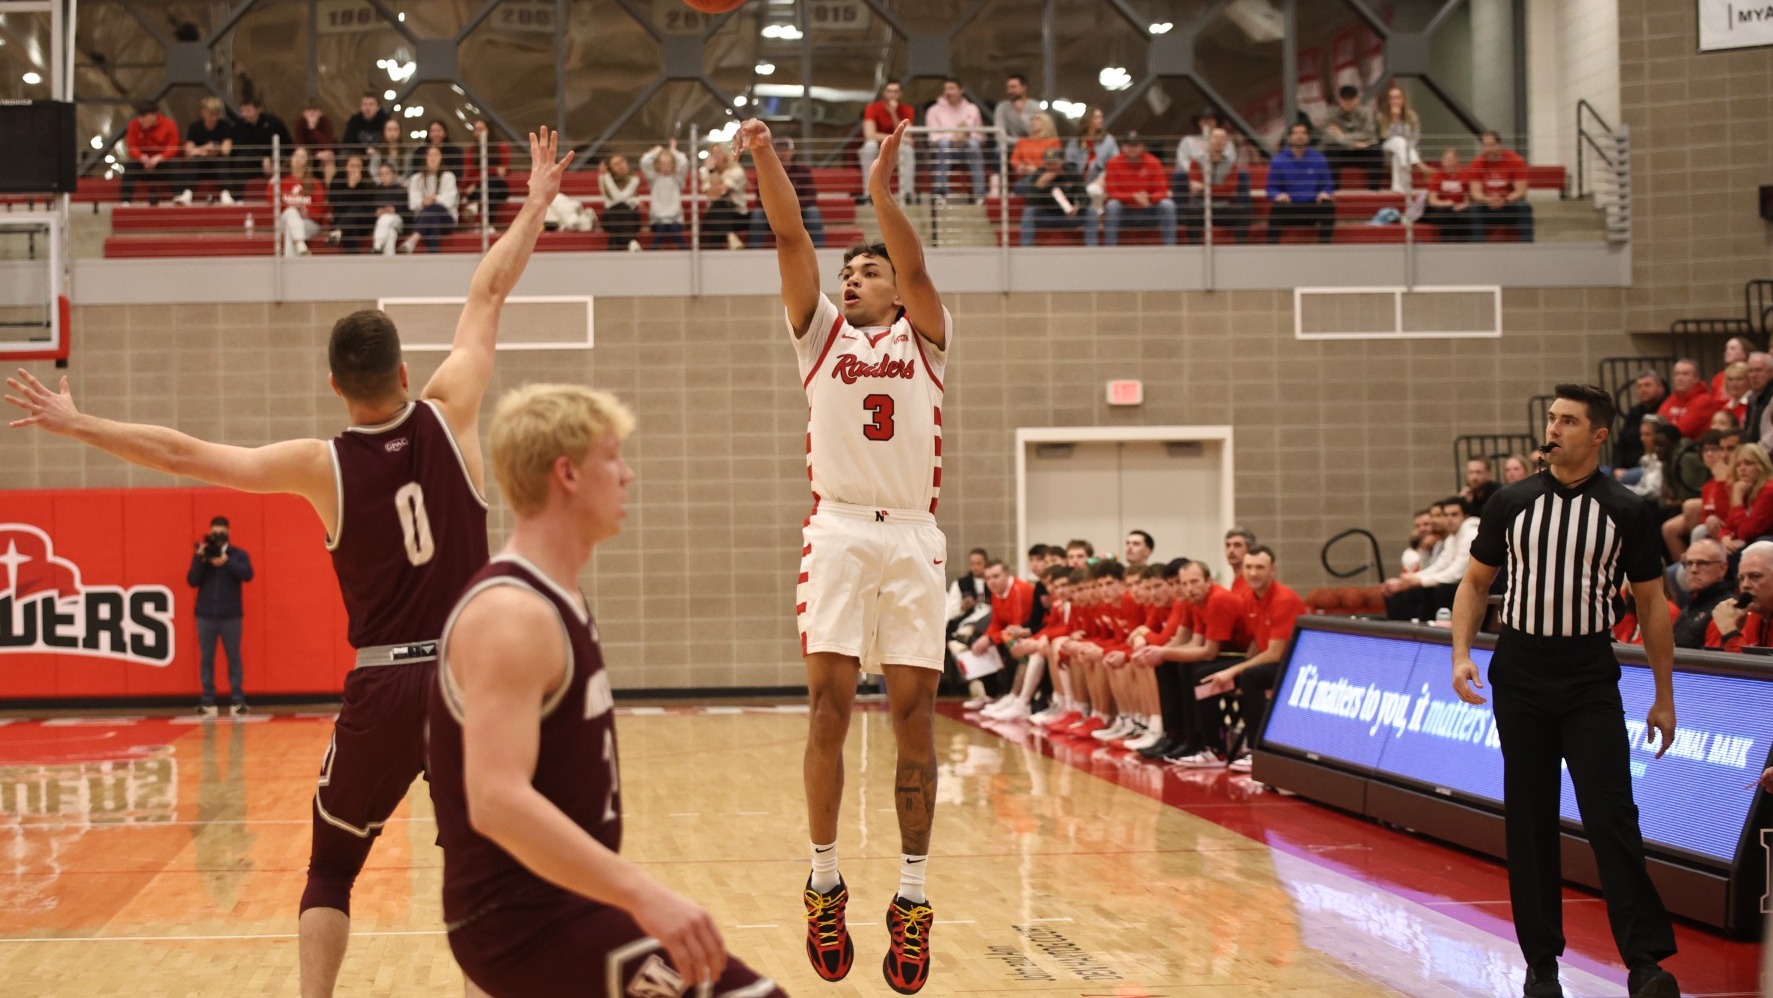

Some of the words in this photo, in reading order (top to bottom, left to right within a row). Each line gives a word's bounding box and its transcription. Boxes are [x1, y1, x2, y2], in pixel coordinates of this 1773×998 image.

[863, 394, 894, 441] 3
[395, 481, 435, 567] 0
[1309, 677, 1366, 719] matters
[1359, 683, 1381, 722] to
[1407, 682, 1431, 732] it
[1421, 699, 1491, 744] matters
[1707, 733, 1755, 769] BANK
